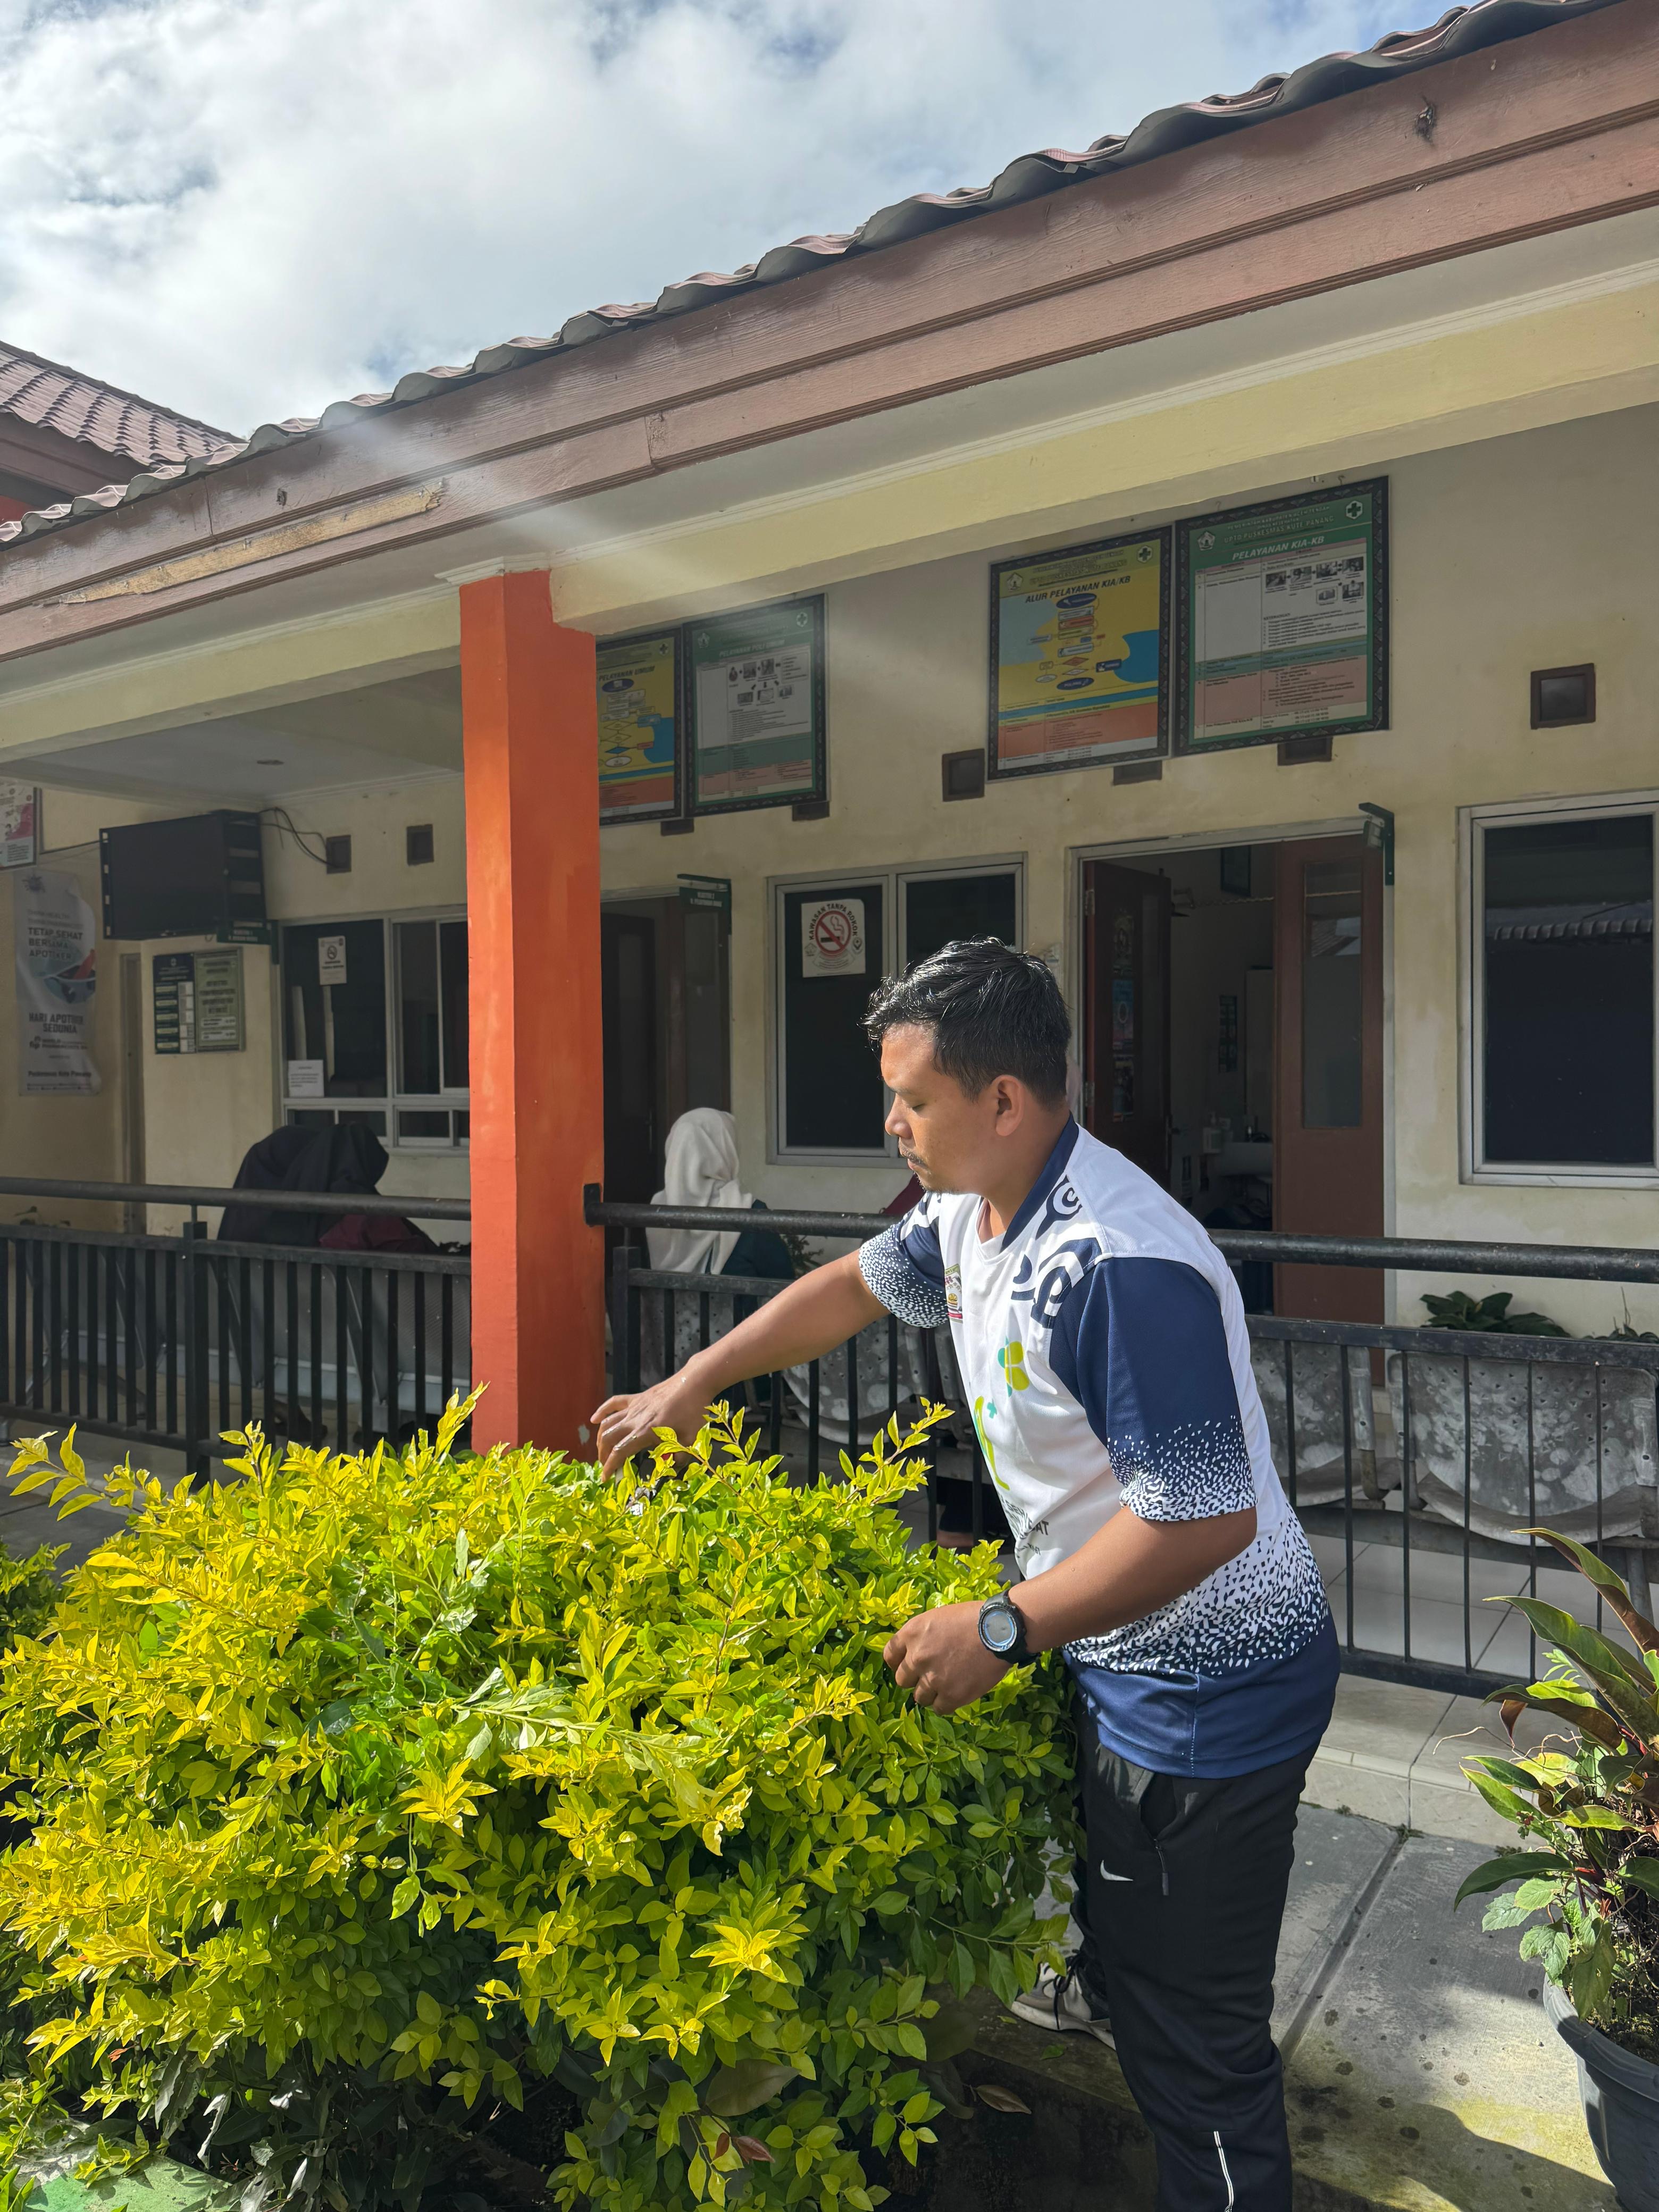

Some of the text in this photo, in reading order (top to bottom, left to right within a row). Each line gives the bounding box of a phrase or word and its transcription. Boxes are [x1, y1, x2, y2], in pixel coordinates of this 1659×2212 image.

[1243, 526, 1285, 539] PUSKESMAS
[1306, 516, 1334, 526] PANANG
[1232, 535, 1325, 561] PELAYANAN KIA-KB
[1025, 575, 1131, 604] ALUR PELAYANAN KIA/KB
[809, 903, 858, 941] KAWASAN TANPA ROKOK
[28, 927, 83, 940] TETAP SEHAT
[29, 937, 69, 949] BERSAMA
[29, 1012, 47, 1022] HARI
[43, 1023, 78, 1034] SEDUNIA
